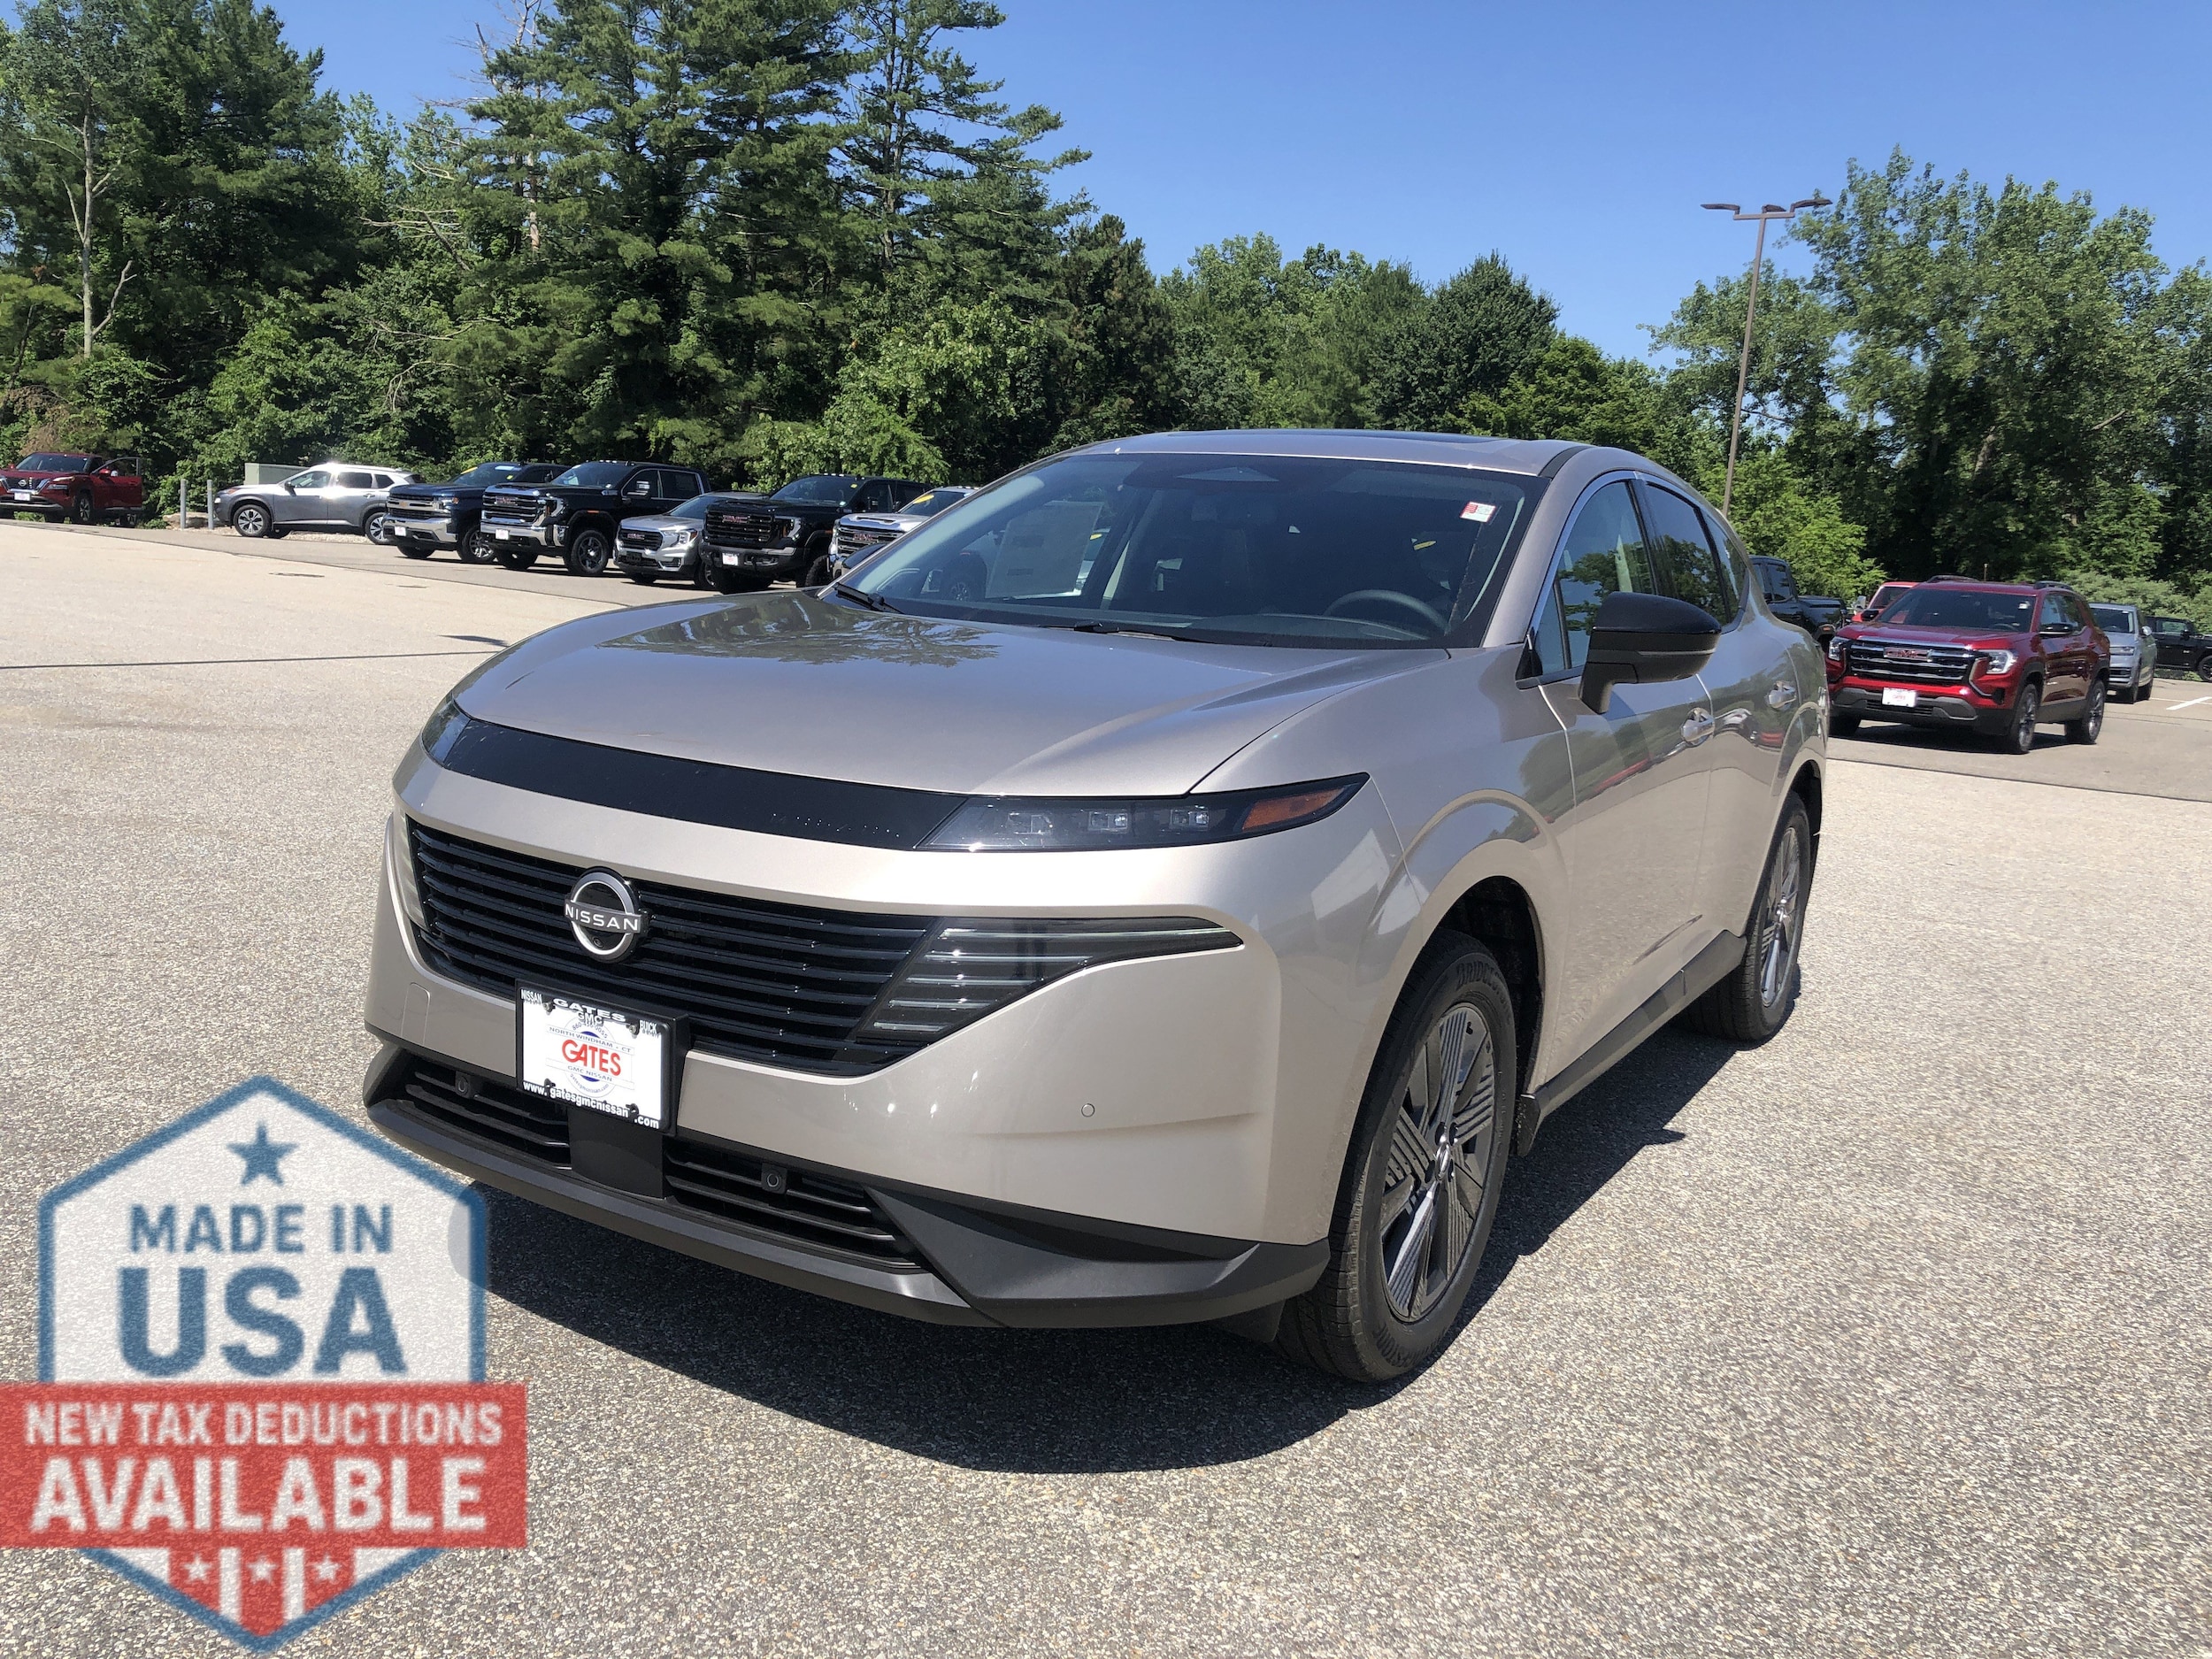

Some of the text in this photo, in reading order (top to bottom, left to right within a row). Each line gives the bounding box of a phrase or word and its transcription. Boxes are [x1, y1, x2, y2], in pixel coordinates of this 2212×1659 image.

[565, 903, 638, 931] NISSAN
[521, 989, 542, 1003] NISSAN
[553, 998, 626, 1022] GATES
[577, 1011, 603, 1025] GMC
[640, 1019, 657, 1034] BUICK
[549, 1026, 575, 1037] NORTH
[576, 1033, 613, 1048] WINDHAM
[562, 1039, 621, 1076] GATES
[586, 1070, 612, 1082] NISSAN
